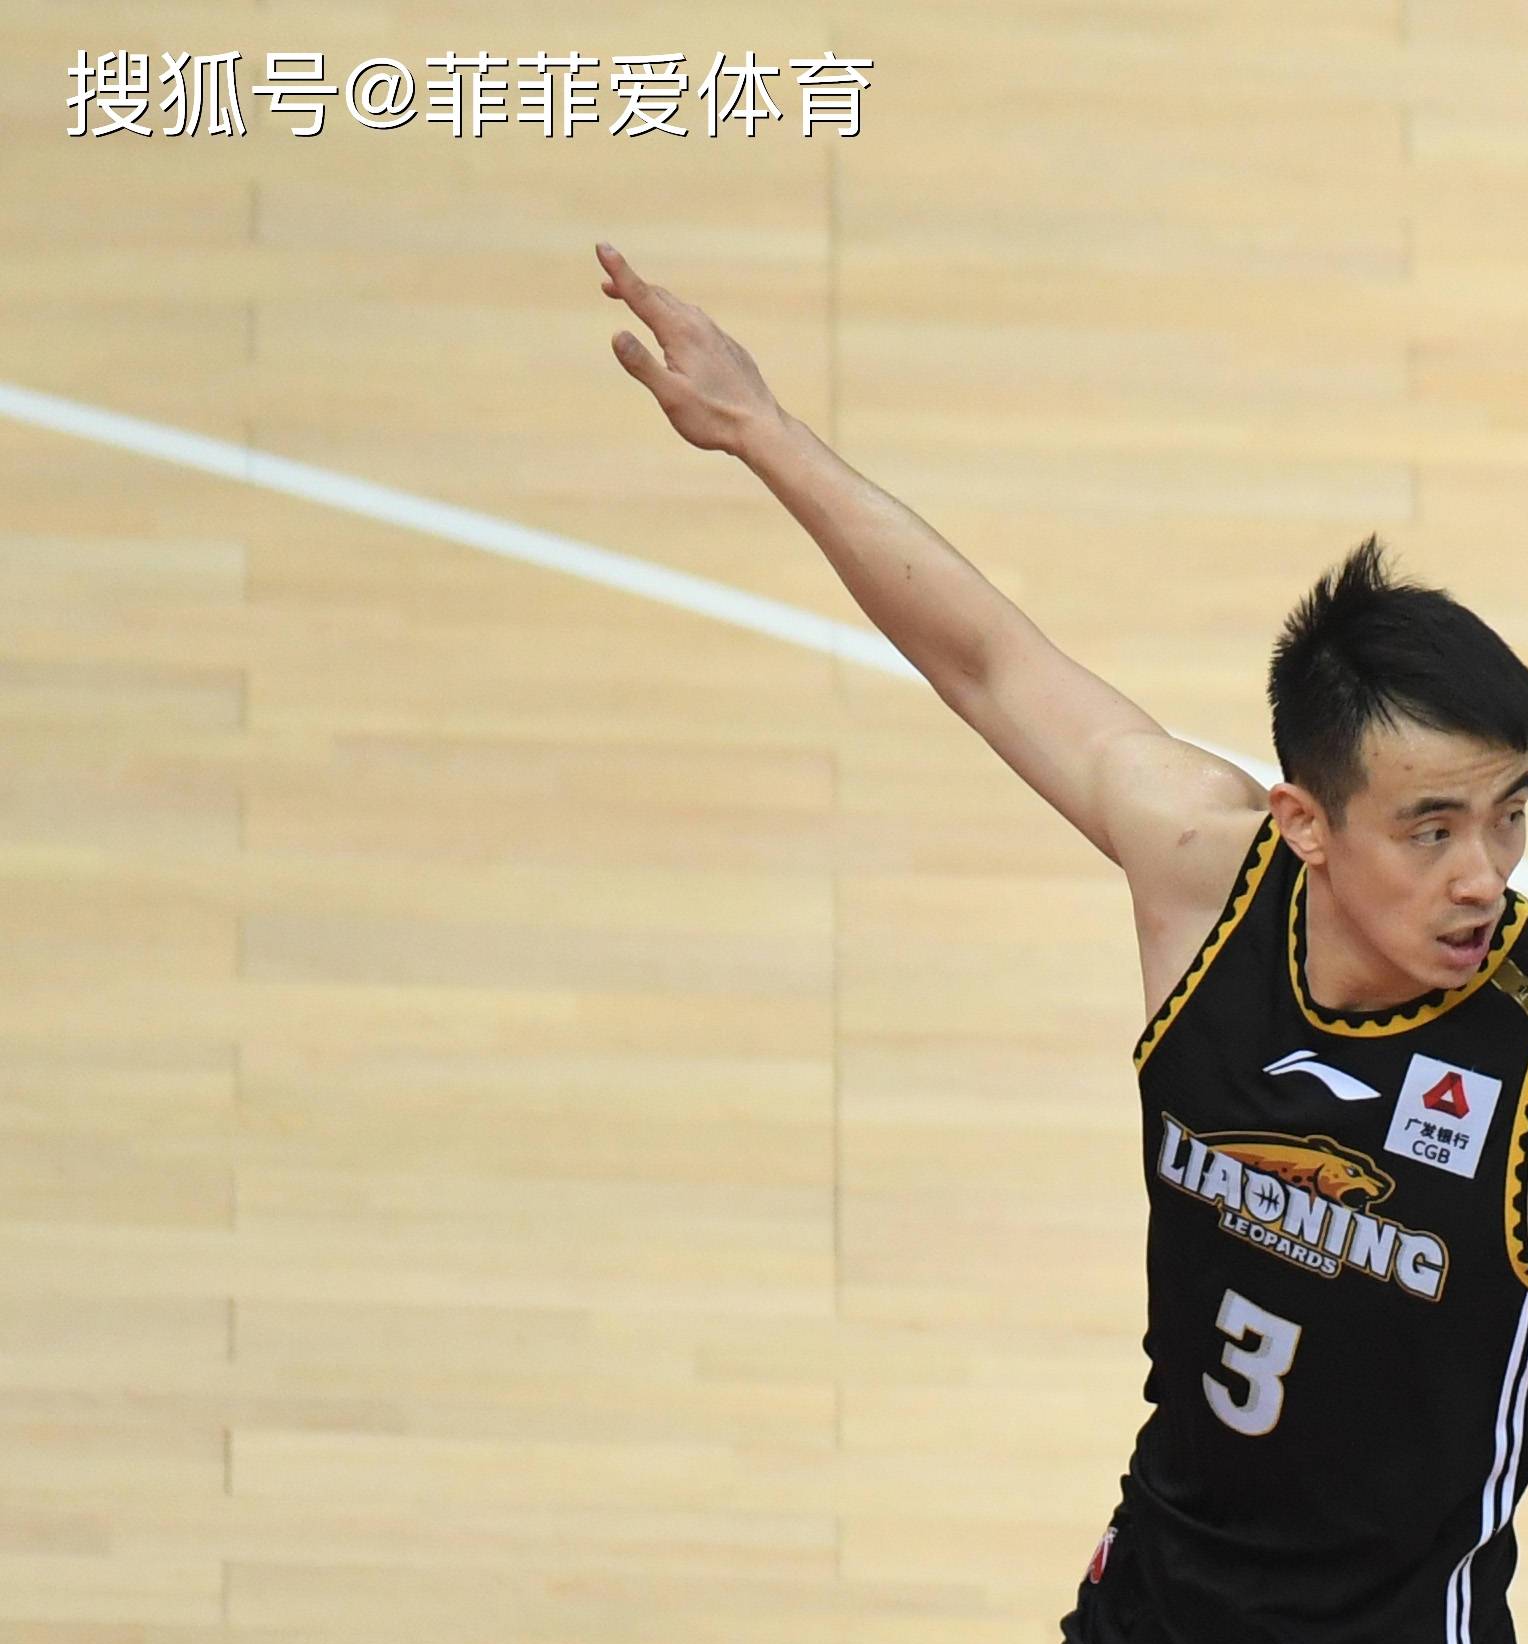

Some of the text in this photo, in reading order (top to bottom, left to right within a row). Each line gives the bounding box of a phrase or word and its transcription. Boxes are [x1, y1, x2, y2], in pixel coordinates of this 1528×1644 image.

[1404, 1117, 1470, 1150] 广发银行
[1411, 1140, 1451, 1164] CGB
[1158, 1114, 1446, 1300] LIAONING
[1221, 1211, 1339, 1276] LEOPARDS
[1202, 1288, 1302, 1437] 3
